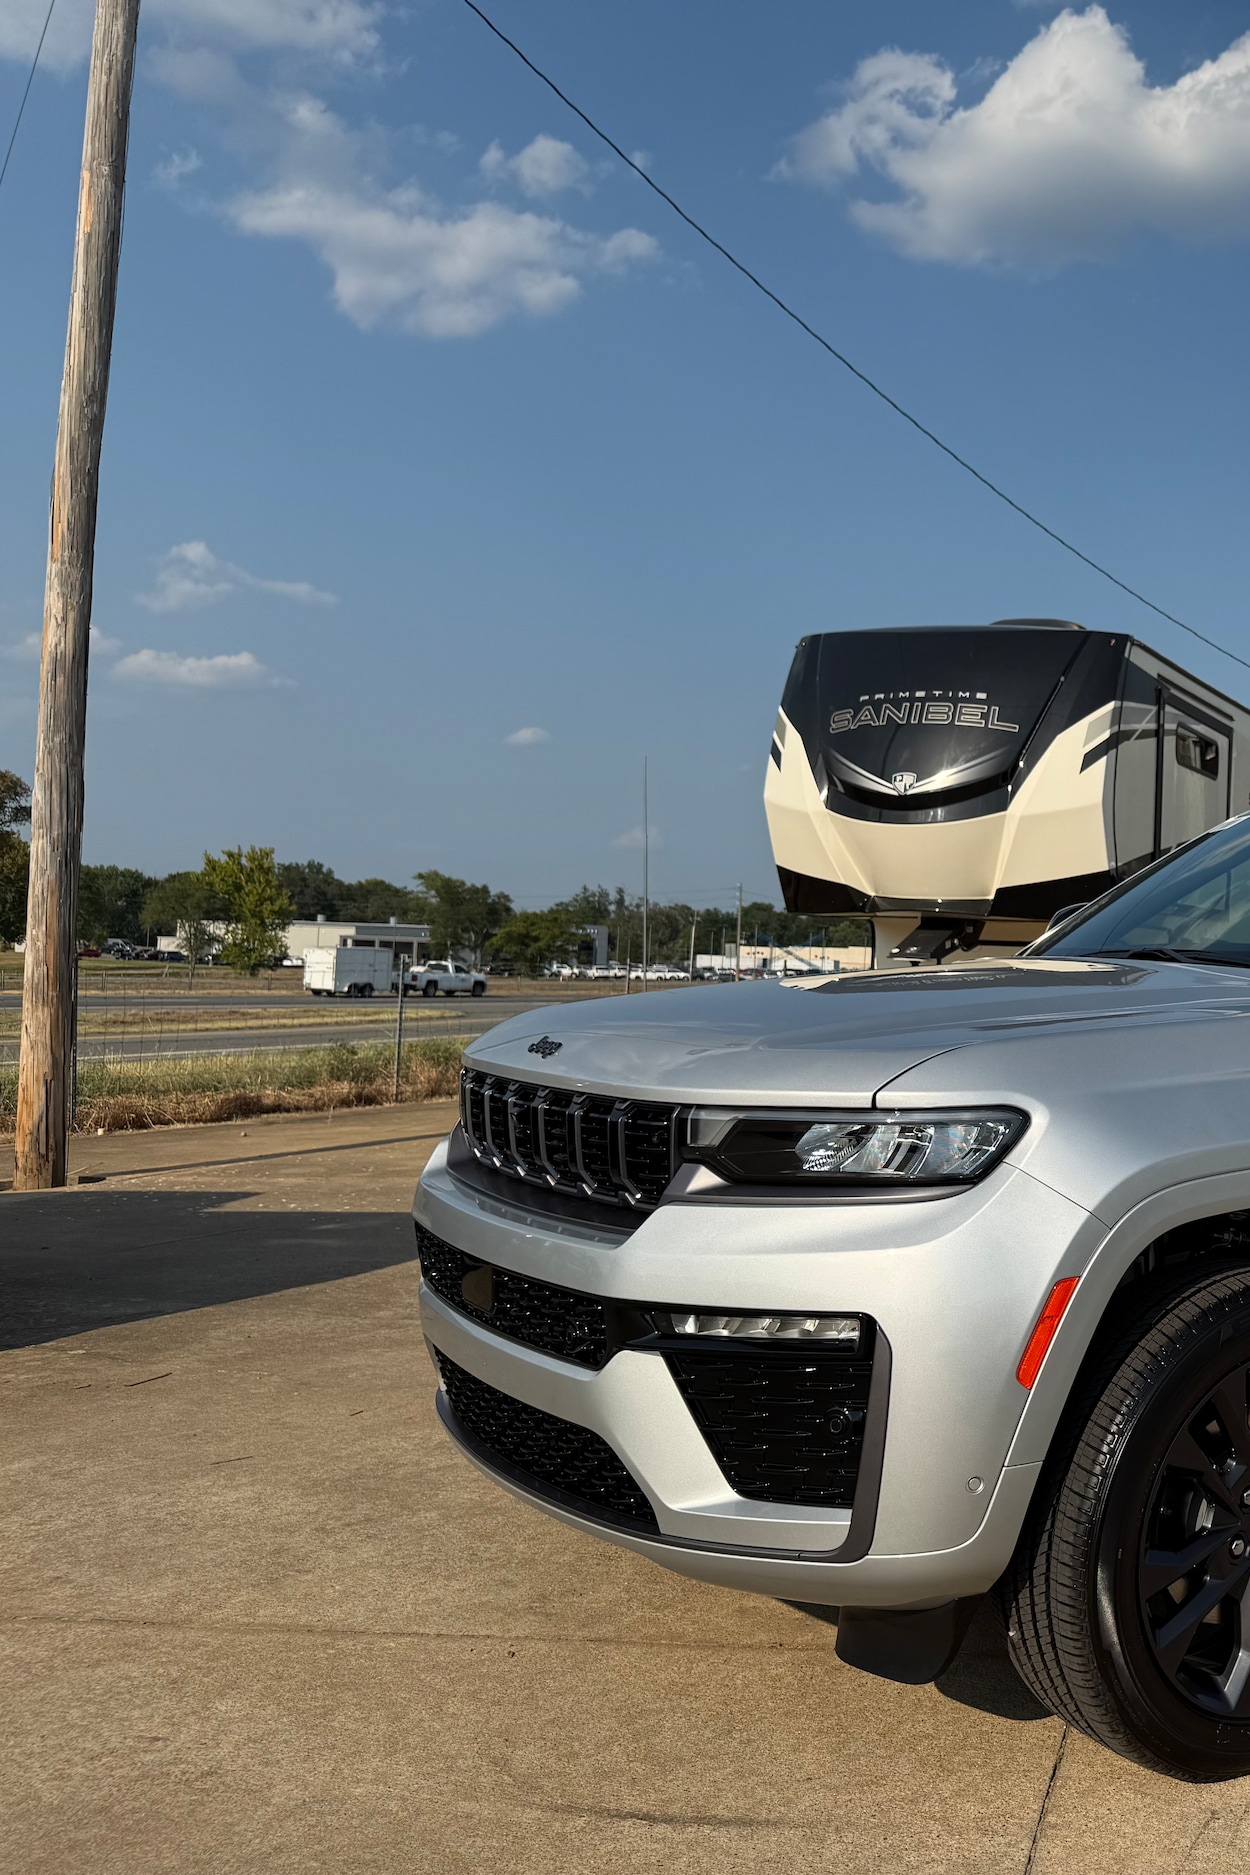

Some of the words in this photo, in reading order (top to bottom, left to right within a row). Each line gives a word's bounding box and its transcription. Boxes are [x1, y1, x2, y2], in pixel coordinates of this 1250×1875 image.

[859, 690, 988, 703] PRIMETIME
[829, 702, 1020, 734] SANIBEL
[527, 1035, 563, 1060] Jeep
